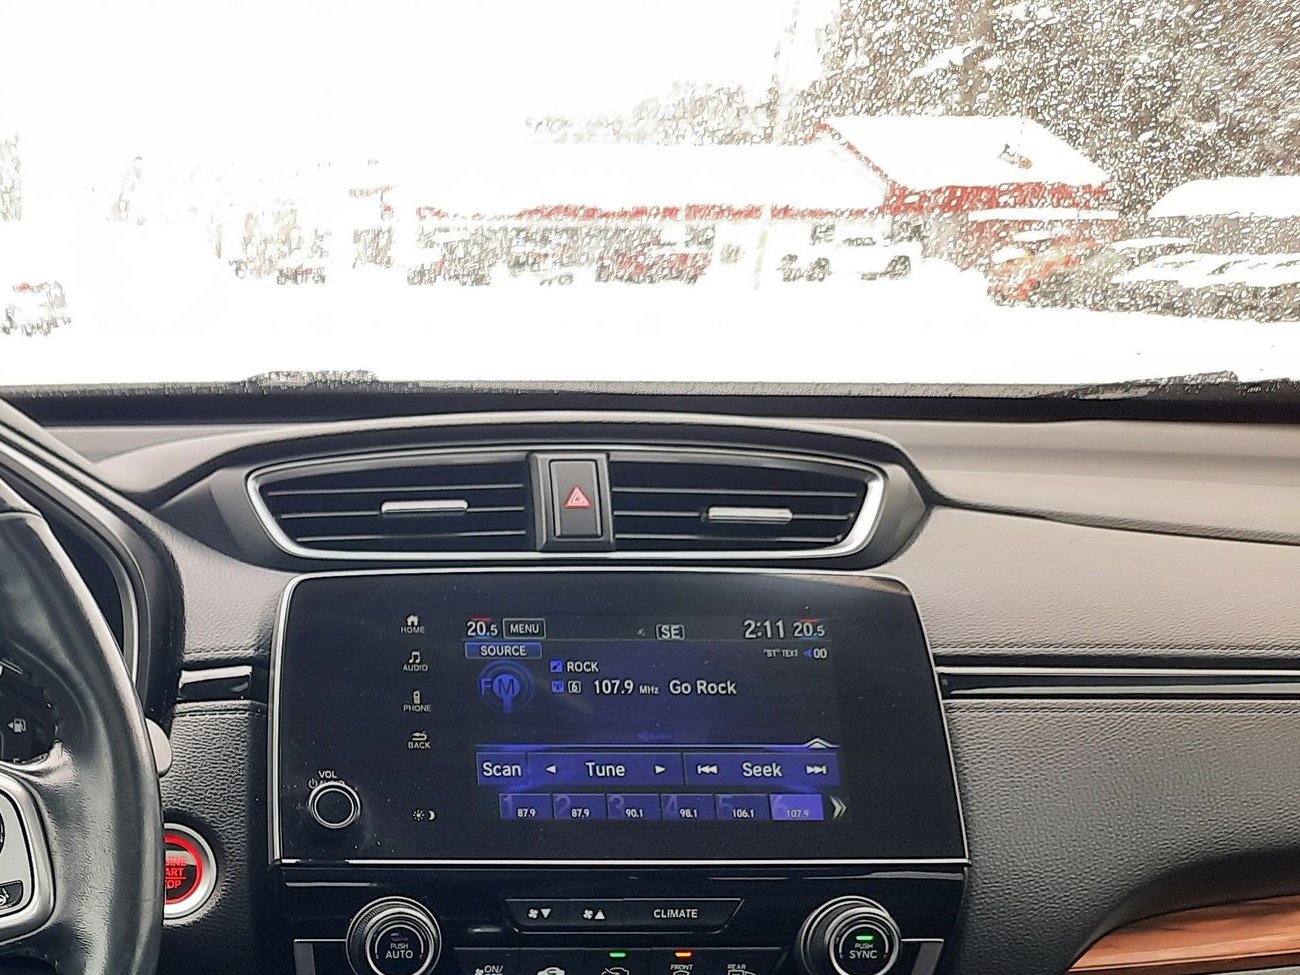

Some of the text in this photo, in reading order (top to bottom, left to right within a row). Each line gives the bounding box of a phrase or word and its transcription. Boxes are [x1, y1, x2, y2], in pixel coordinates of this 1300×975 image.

[400, 626, 426, 634] HOME
[466, 620, 498, 637] 20.5
[509, 622, 540, 634] MENU
[661, 624, 680, 639] SE
[743, 619, 785, 639] 2:11
[792, 621, 826, 637] 20.5
[480, 645, 527, 657] SOURCE
[813, 647, 828, 659] 00
[402, 663, 429, 672] AUDIO
[566, 661, 599, 673] ROCK
[593, 680, 635, 695] 107.9
[639, 685, 660, 695] MHz
[669, 680, 692, 695] Go
[696, 680, 737, 695] Rock
[403, 704, 432, 713] PHONE
[407, 741, 431, 750] BACK
[482, 761, 522, 777] Scan
[585, 761, 625, 777] Tune
[741, 761, 782, 777] Seek
[318, 770, 338, 779] VOL
[517, 808, 536, 818] 87.9
[571, 808, 590, 818] 87.9
[625, 808, 643, 818] 90.1
[679, 808, 698, 818] 98.1
[731, 808, 755, 818] 106.1
[786, 809, 809, 818] 107.9
[653, 909, 698, 919] CLIMATE
[385, 950, 414, 959] AUTO
[849, 950, 878, 960] SYNC
[484, 965, 504, 974] ON/
